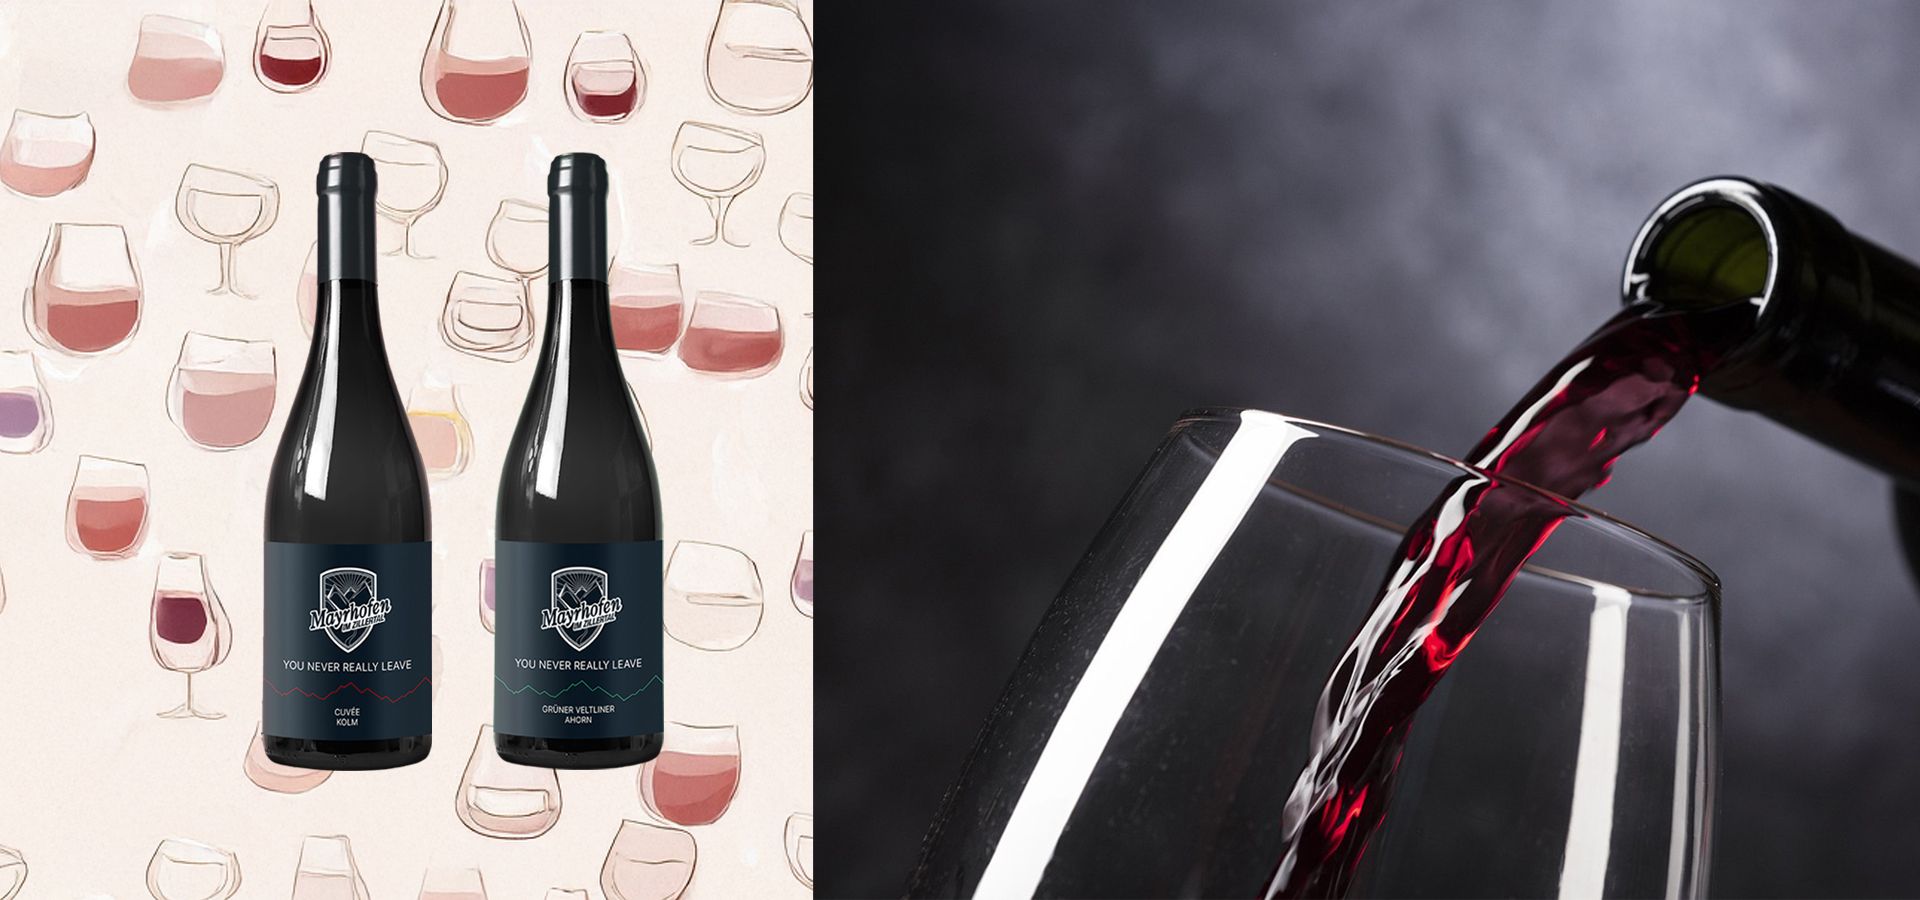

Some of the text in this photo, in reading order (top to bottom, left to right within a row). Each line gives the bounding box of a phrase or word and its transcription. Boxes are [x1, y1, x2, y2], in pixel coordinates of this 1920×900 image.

[310, 598, 392, 630] Mayrhofen
[541, 597, 623, 629] Mayrhofen
[352, 614, 385, 629] ZILLERTAL
[583, 613, 616, 629] ZILLERTAL
[283, 660, 412, 672] YOU NEVER REALLY LEAVE
[514, 658, 642, 670] YOU NEVER REALLY LEAVE
[334, 706, 360, 716] CUVÉE
[542, 704, 615, 714] GRÜNER VELTLINER
[336, 718, 359, 726] KOLM
[564, 716, 592, 724] AHORN
